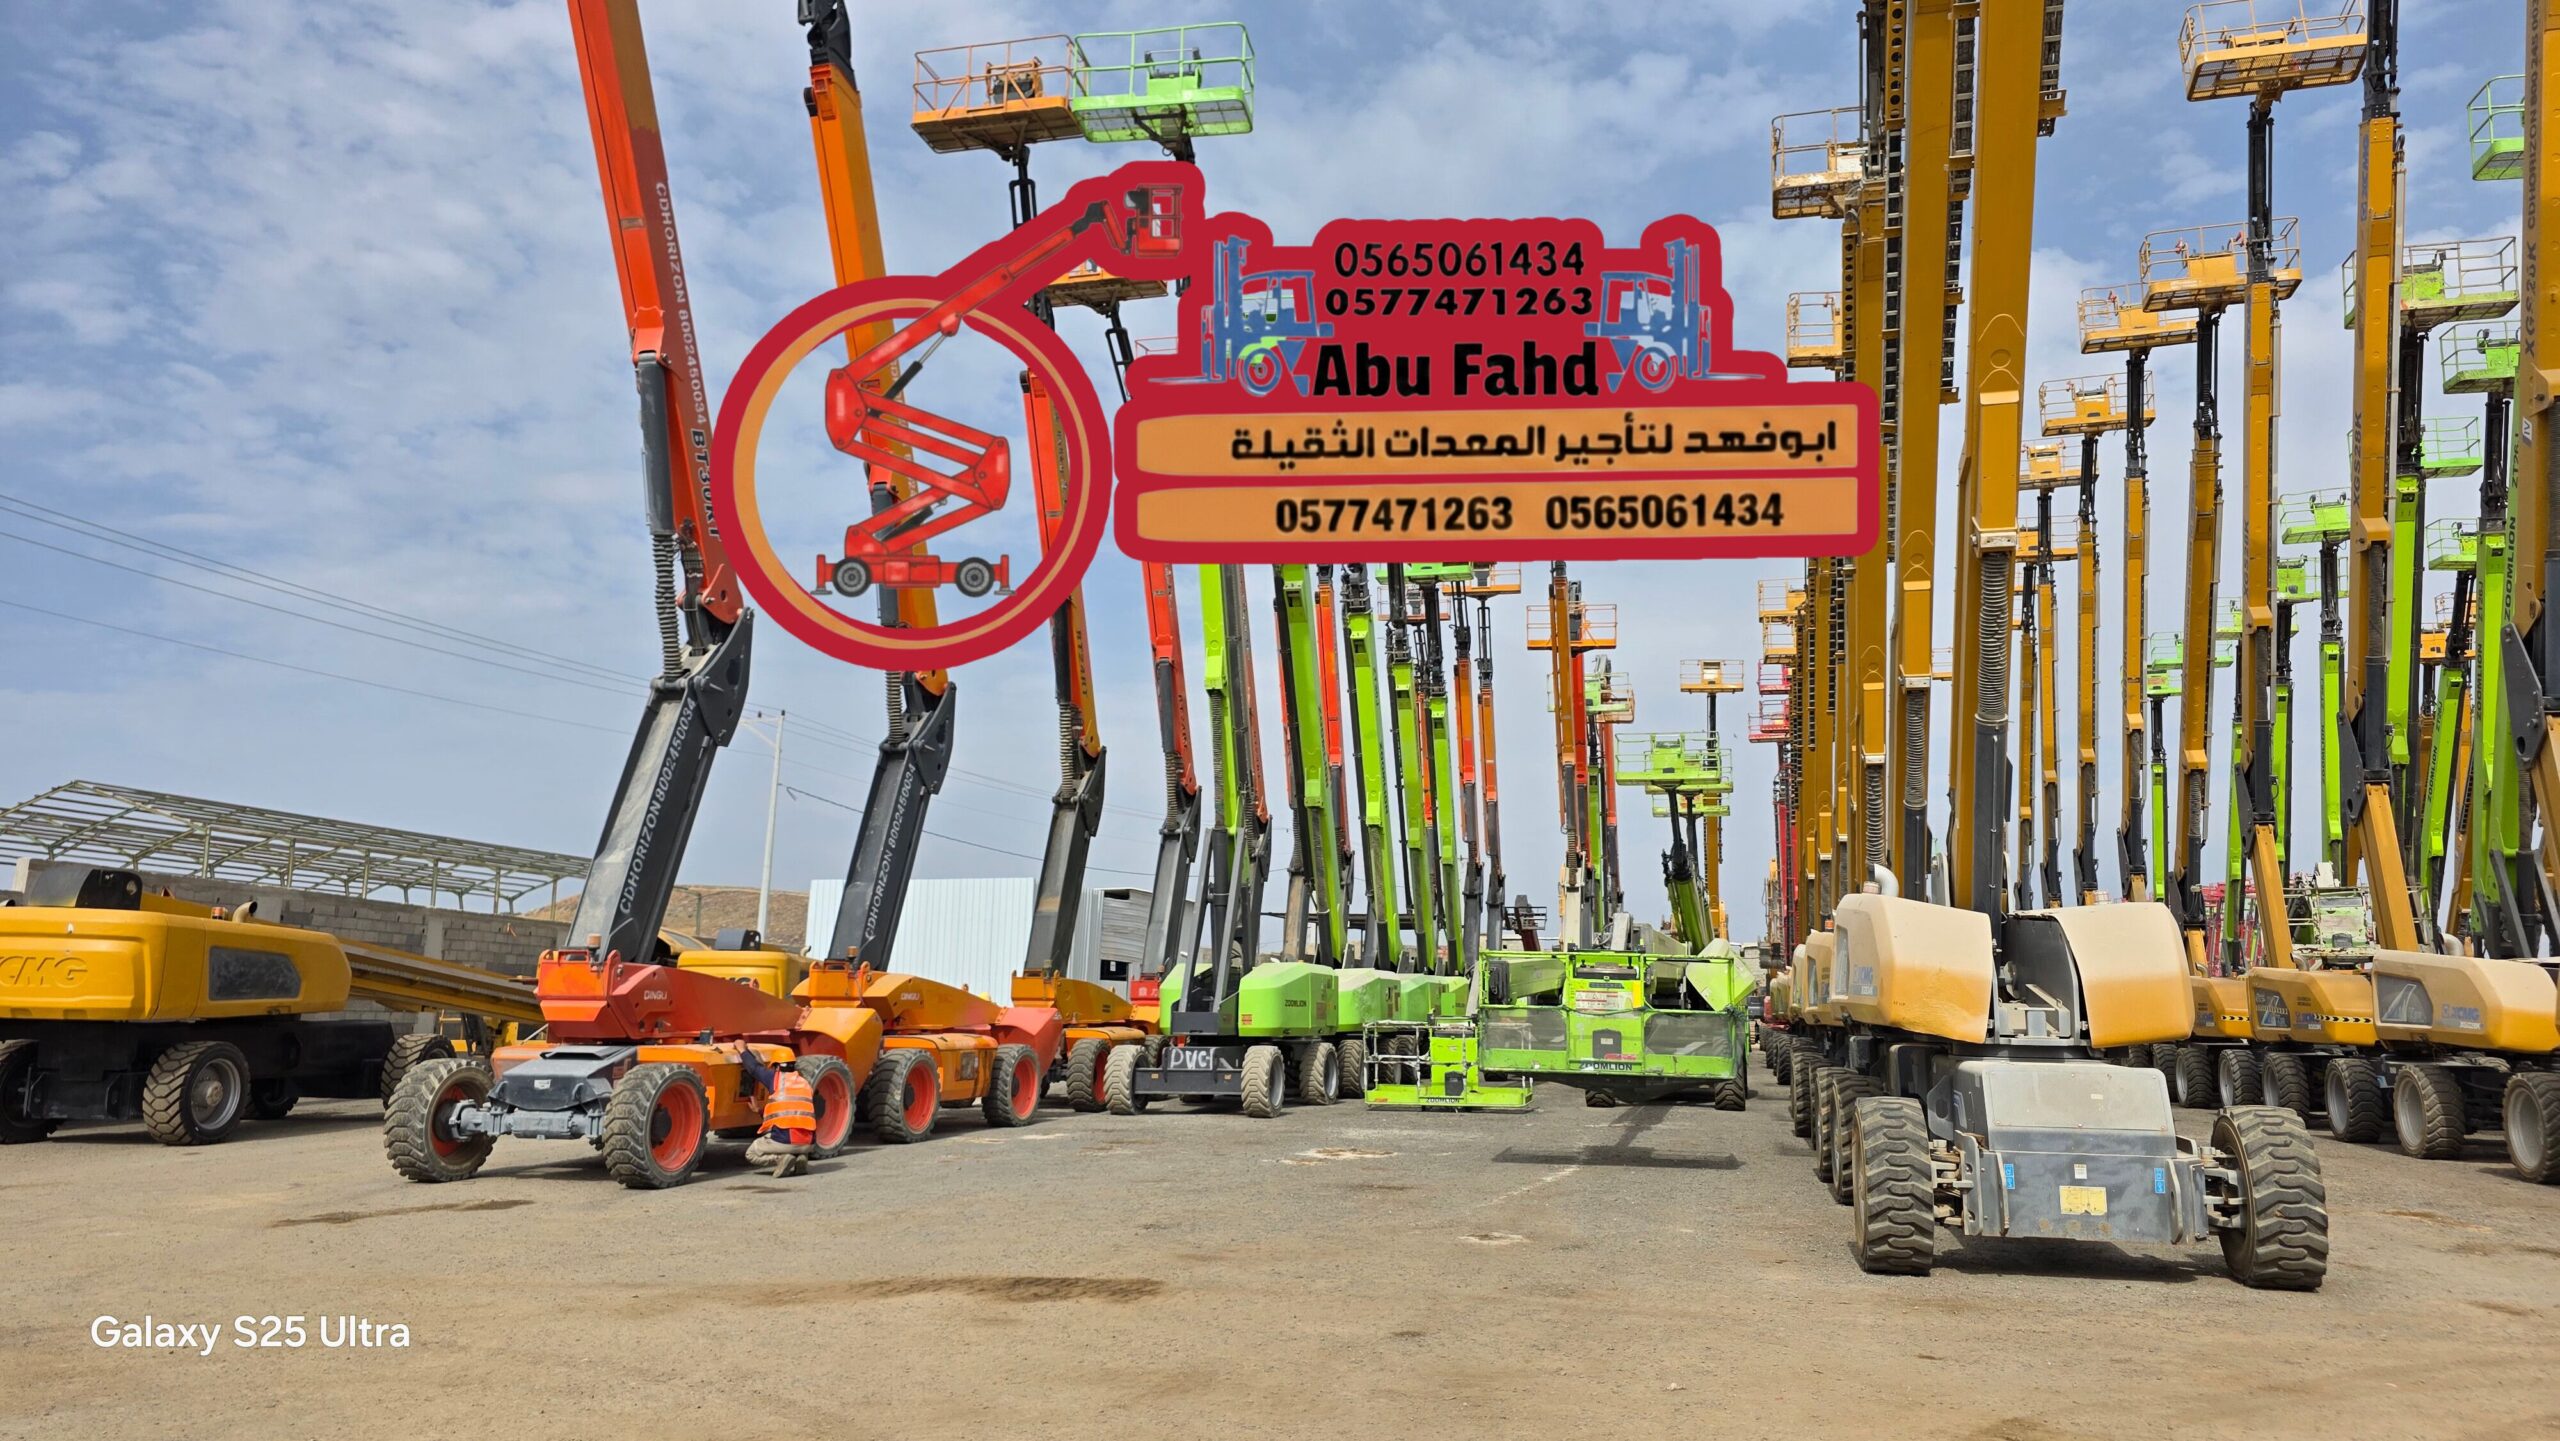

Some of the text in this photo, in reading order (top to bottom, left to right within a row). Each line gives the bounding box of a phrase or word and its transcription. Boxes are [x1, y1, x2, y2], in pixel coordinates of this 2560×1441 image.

[656, 182, 686, 304] CDHORIZON
[2353, 411, 2362, 508] XGS28K
[2503, 516, 2516, 622] ZOOMLION
[2476, 643, 2484, 721] ZOOMLION
[620, 697, 697, 914] CDHORIZON 8002450034
[2427, 745, 2438, 803] ZOOMLION
[865, 762, 916, 940] CDHORIZON 8002450034
